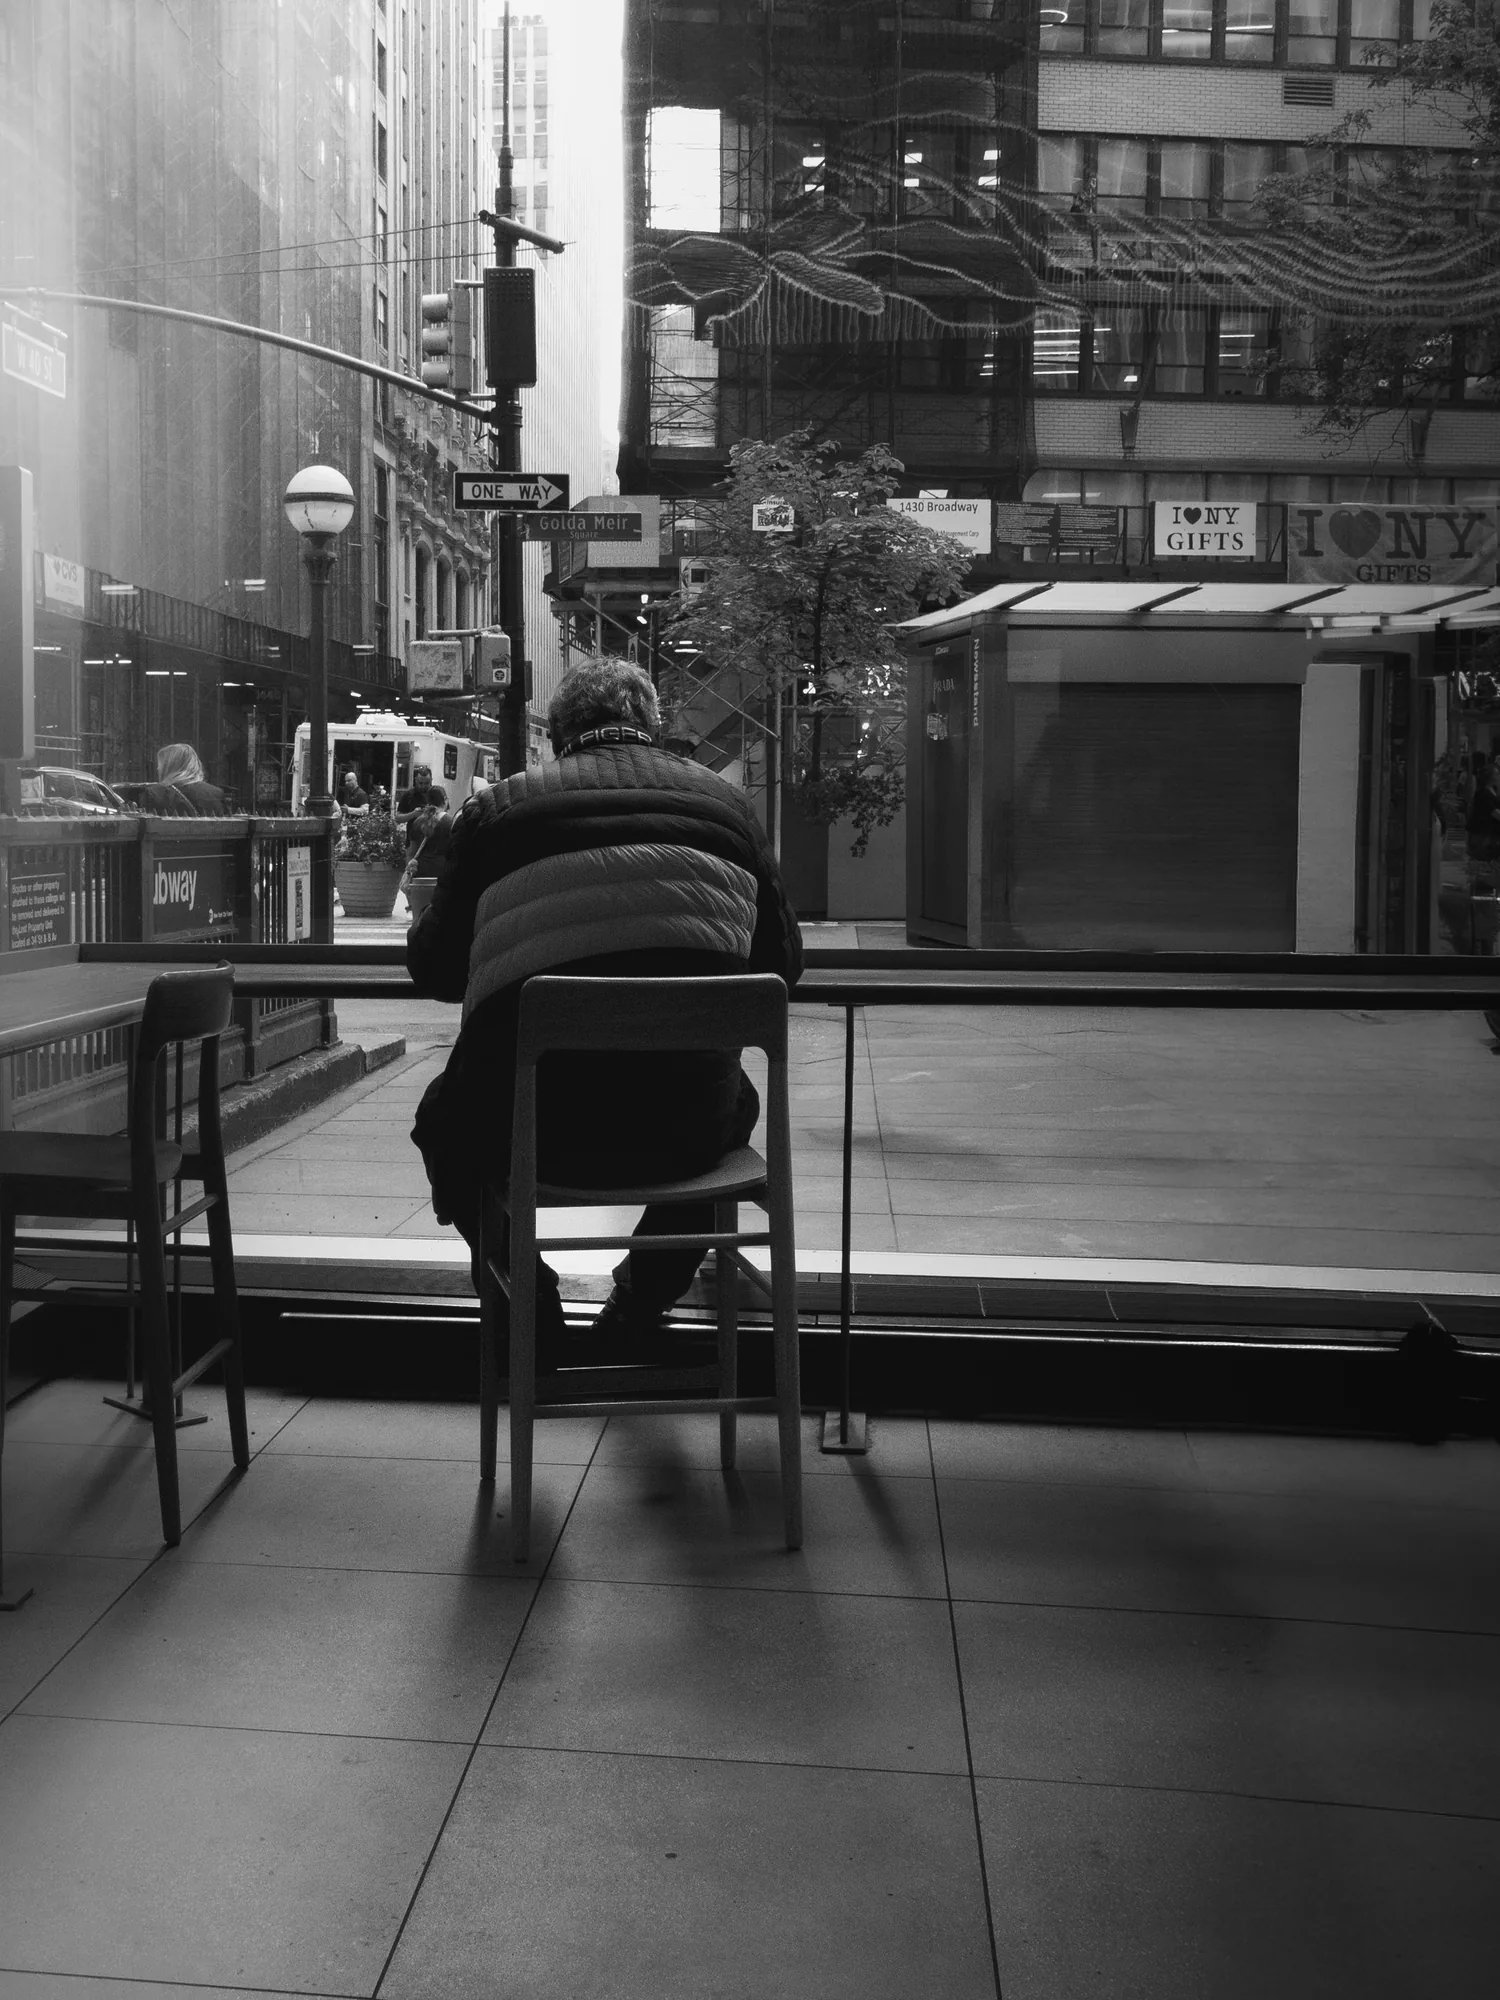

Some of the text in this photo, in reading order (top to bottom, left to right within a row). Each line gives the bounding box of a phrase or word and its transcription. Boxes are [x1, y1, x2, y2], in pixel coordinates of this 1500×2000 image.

[17, 341, 27, 369] W
[29, 349, 41, 376] 40
[471, 484, 553, 500] ONE WAY
[900, 501, 979, 515] 1430 Broadway
[1172, 507, 1240, 525] I NY
[540, 515, 629, 531] Golda Meir
[570, 530, 599, 540] Square
[1167, 532, 1244, 551] GIFTS
[1296, 509, 1486, 559] I NY
[62, 561, 78, 583] CVS
[1356, 564, 1432, 583] GIFTS
[933, 678, 955, 693] PRADA
